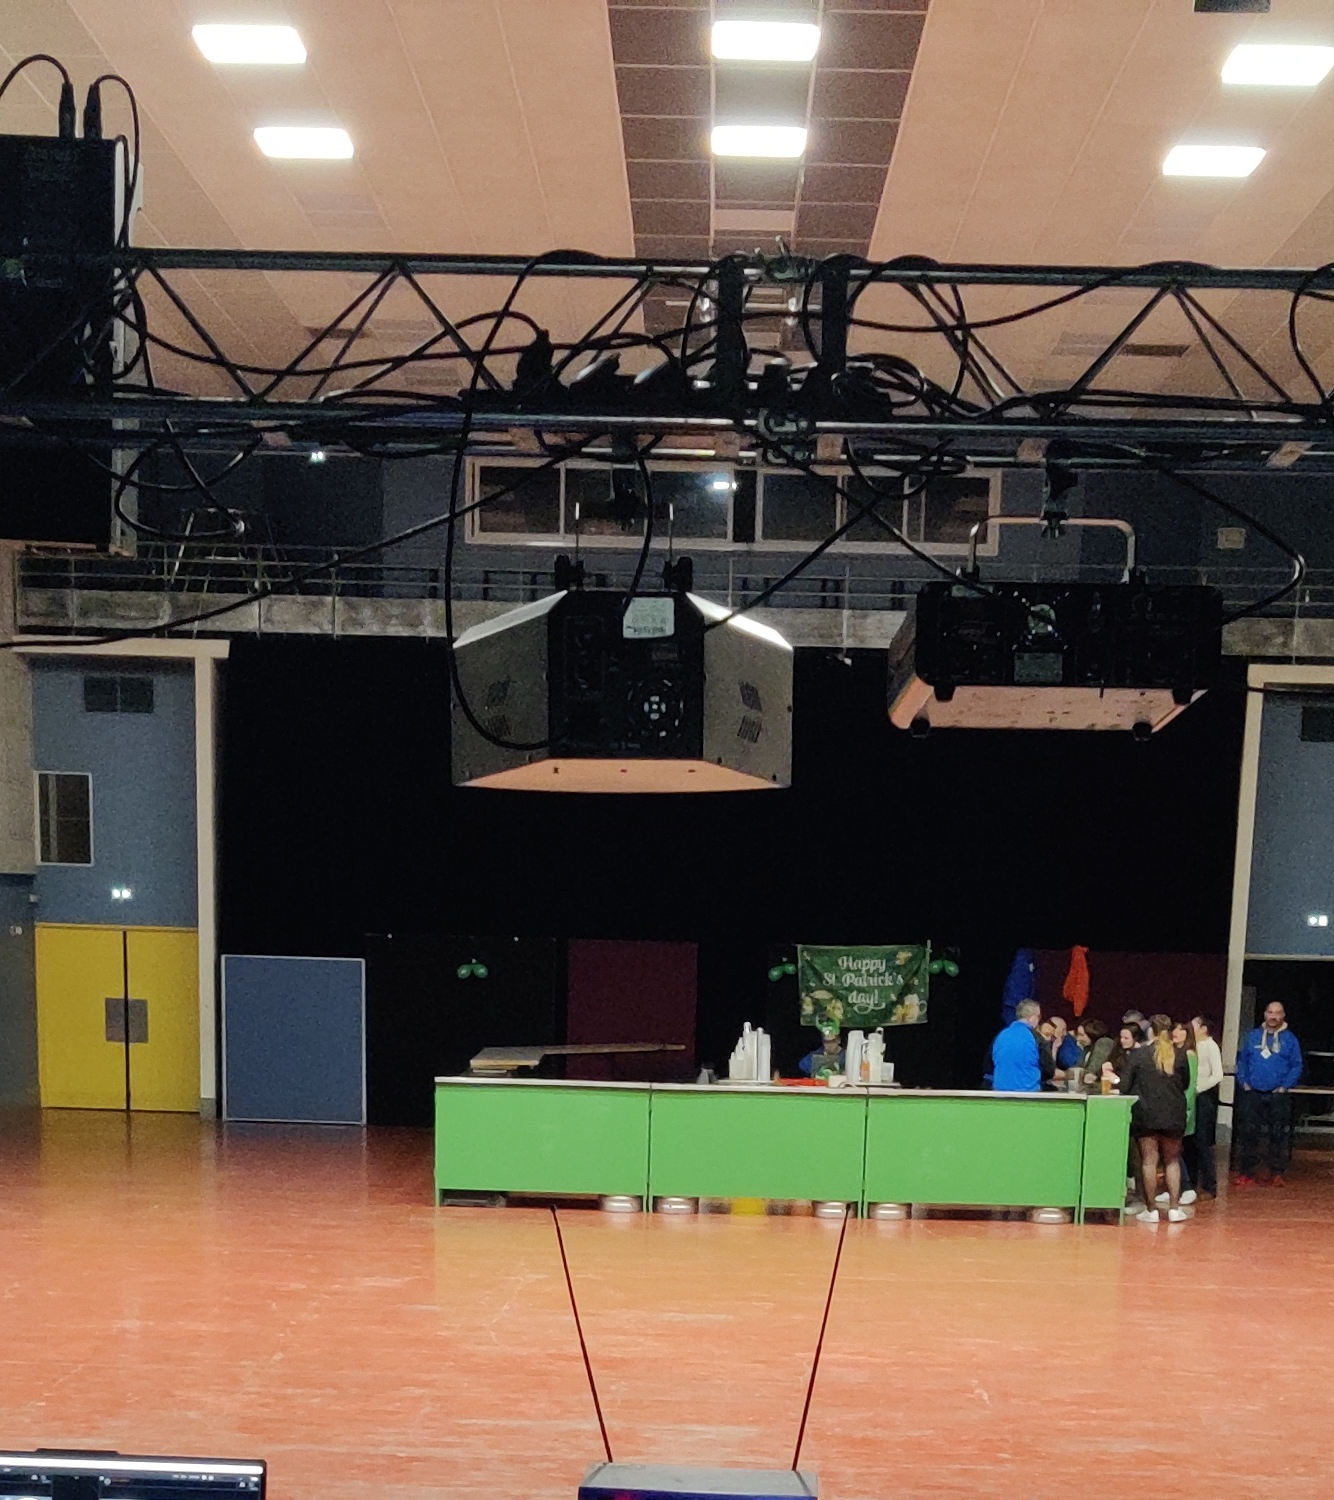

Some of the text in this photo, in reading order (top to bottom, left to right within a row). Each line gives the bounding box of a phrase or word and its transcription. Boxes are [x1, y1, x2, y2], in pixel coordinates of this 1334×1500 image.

[837, 955, 887, 974] Happy
[841, 971, 904, 988] Patrick's
[847, 989, 886, 1014] day!
